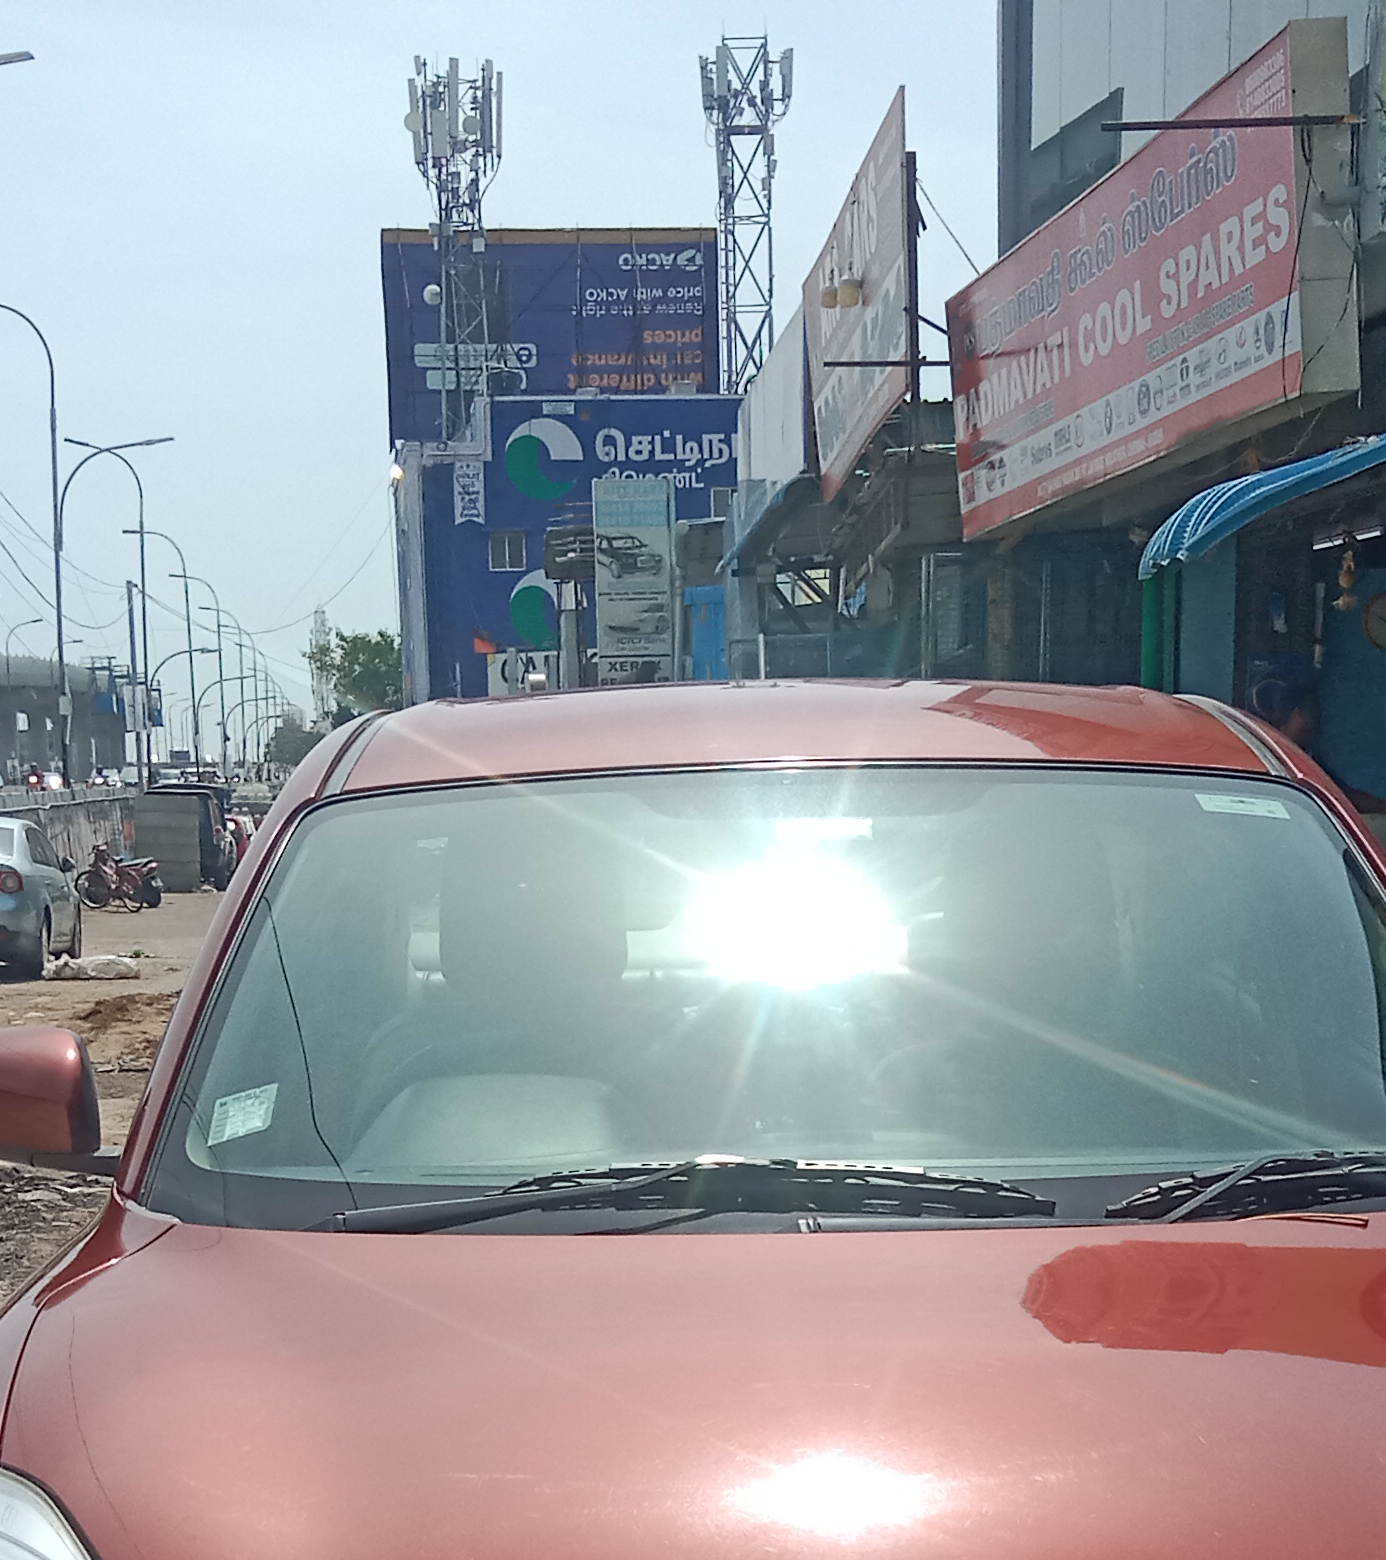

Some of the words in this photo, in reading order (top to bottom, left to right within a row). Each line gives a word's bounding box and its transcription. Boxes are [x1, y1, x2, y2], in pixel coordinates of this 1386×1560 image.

[619, 252, 676, 271] ACKO
[585, 288, 628, 301] ACKO
[634, 287, 663, 301] with
[667, 286, 703, 301] price
[610, 303, 633, 317] the
[655, 303, 703, 315] Renew
[953, 327, 1071, 443] PADMAVATI
[1077, 279, 1151, 367] COOL
[1159, 183, 1290, 319] SPARES
[643, 326, 703, 347] prices
[608, 660, 662, 672] XERX
